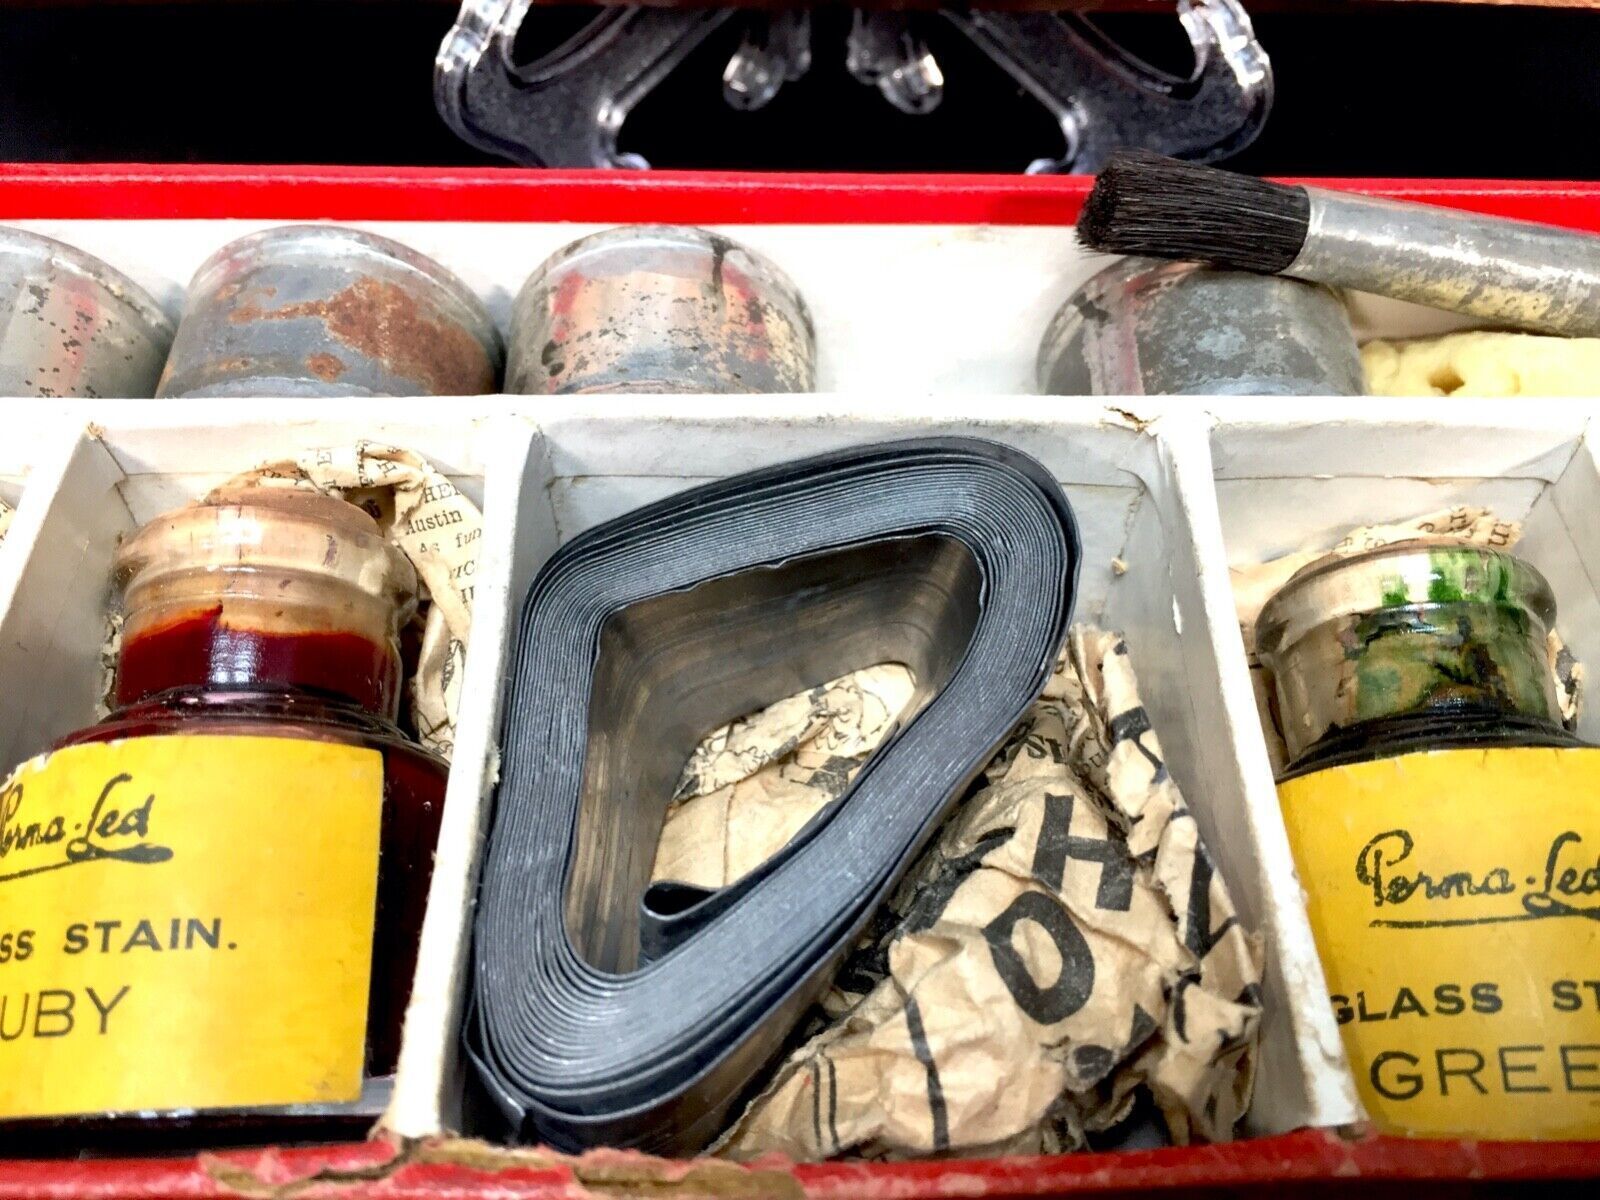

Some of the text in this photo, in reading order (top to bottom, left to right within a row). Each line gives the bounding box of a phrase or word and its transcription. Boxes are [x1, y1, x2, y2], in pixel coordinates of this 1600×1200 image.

[405, 509, 463, 536] Austin
[62, 917, 238, 954] STAIN.
[0, 985, 131, 1042] UBY
[1329, 982, 1503, 1025] GLASS
[1370, 1044, 1600, 1101] GREE
